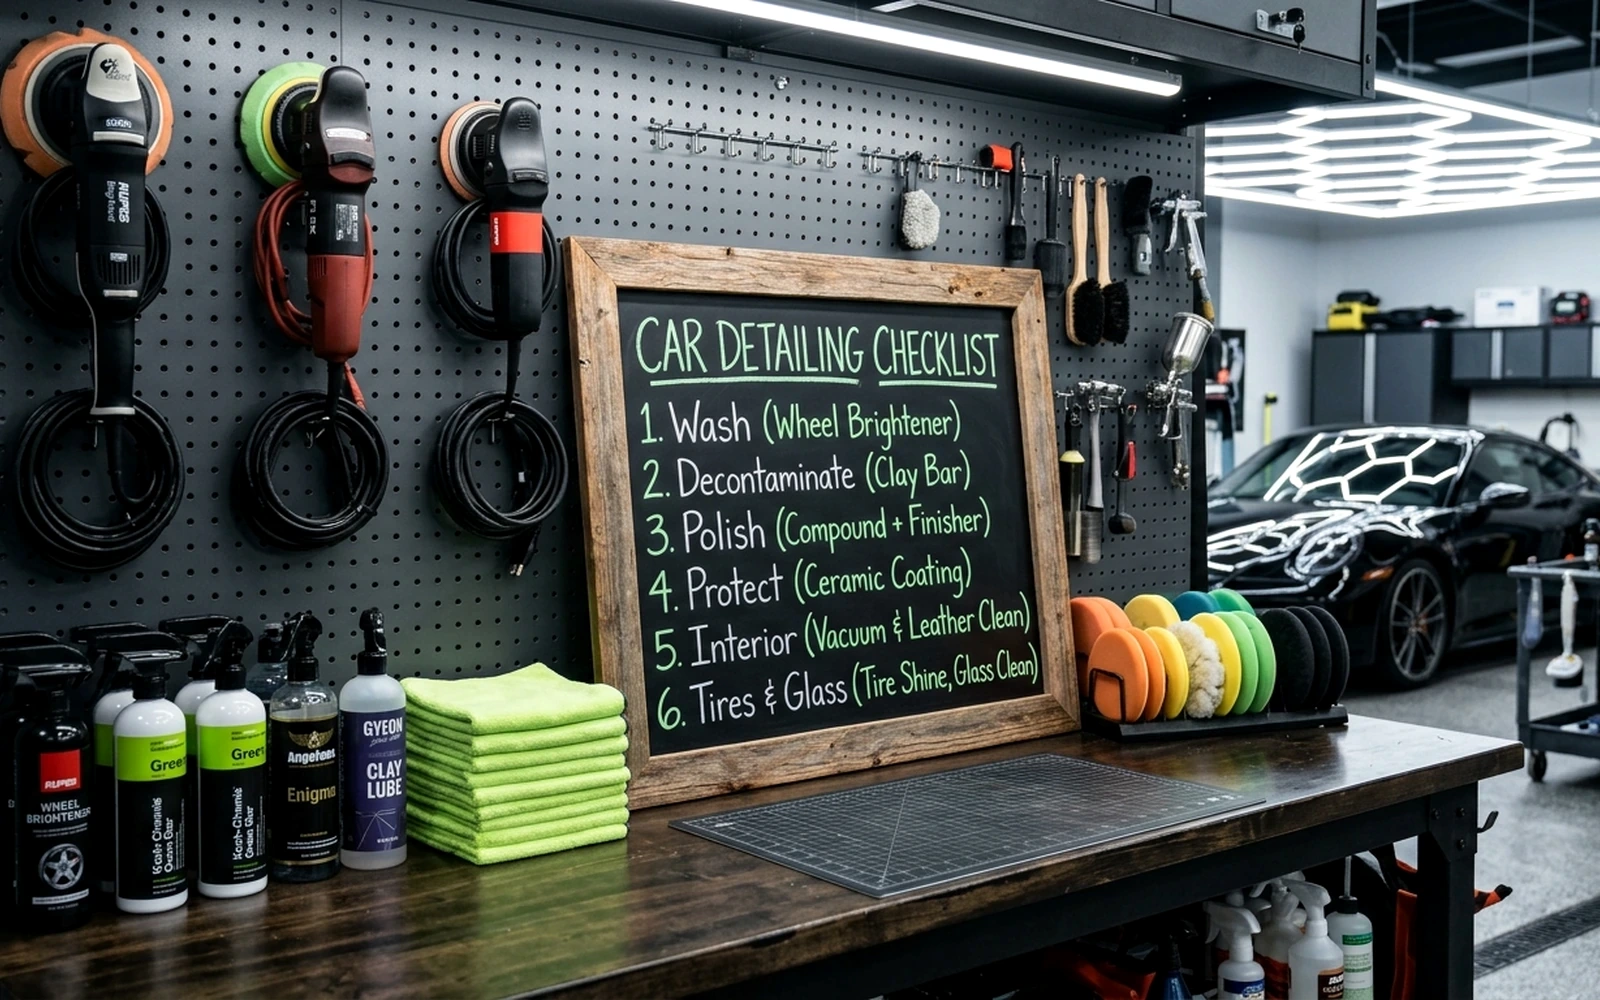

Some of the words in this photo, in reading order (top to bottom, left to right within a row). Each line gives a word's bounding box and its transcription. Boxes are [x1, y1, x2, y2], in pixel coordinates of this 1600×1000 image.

[636, 316, 708, 373] CAR
[715, 320, 864, 373] DETAILING
[873, 325, 999, 377] CHECKLIST
[640, 402, 663, 444] 1.
[668, 400, 751, 443] Wash
[763, 399, 839, 444] (Wheel
[847, 399, 960, 451] Brightener)
[643, 459, 670, 499] 2.
[677, 454, 855, 497] Decontaminate
[866, 452, 918, 499] (Clay
[924, 449, 970, 490] Bar)
[646, 514, 674, 556] 3.
[683, 510, 765, 553] Polish
[776, 506, 886, 553] (Compound
[892, 517, 903, 531] +
[909, 496, 990, 538] Finisher)
[649, 570, 678, 613] 4.
[687, 563, 783, 610] Protect
[795, 558, 885, 604] (Ceramic
[891, 547, 971, 598] Coating)
[655, 629, 682, 671] 5.
[688, 624, 797, 666] Interior
[805, 612, 886, 657] (Vacuum
[893, 613, 902, 642] &
[908, 604, 975, 639] Leather
[979, 591, 1030, 633] Clean)
[658, 687, 686, 730] 6.
[689, 681, 755, 724] Tires
[765, 679, 776, 714] &
[784, 671, 847, 711] Glass
[853, 662, 896, 707] (Tire
[900, 661, 952, 694] Shine,
[954, 654, 994, 685] Glass
[997, 642, 1038, 684] Clean)
[363, 717, 403, 736] GYEON
[367, 759, 402, 780] CLAY
[367, 778, 402, 799] LUBE
